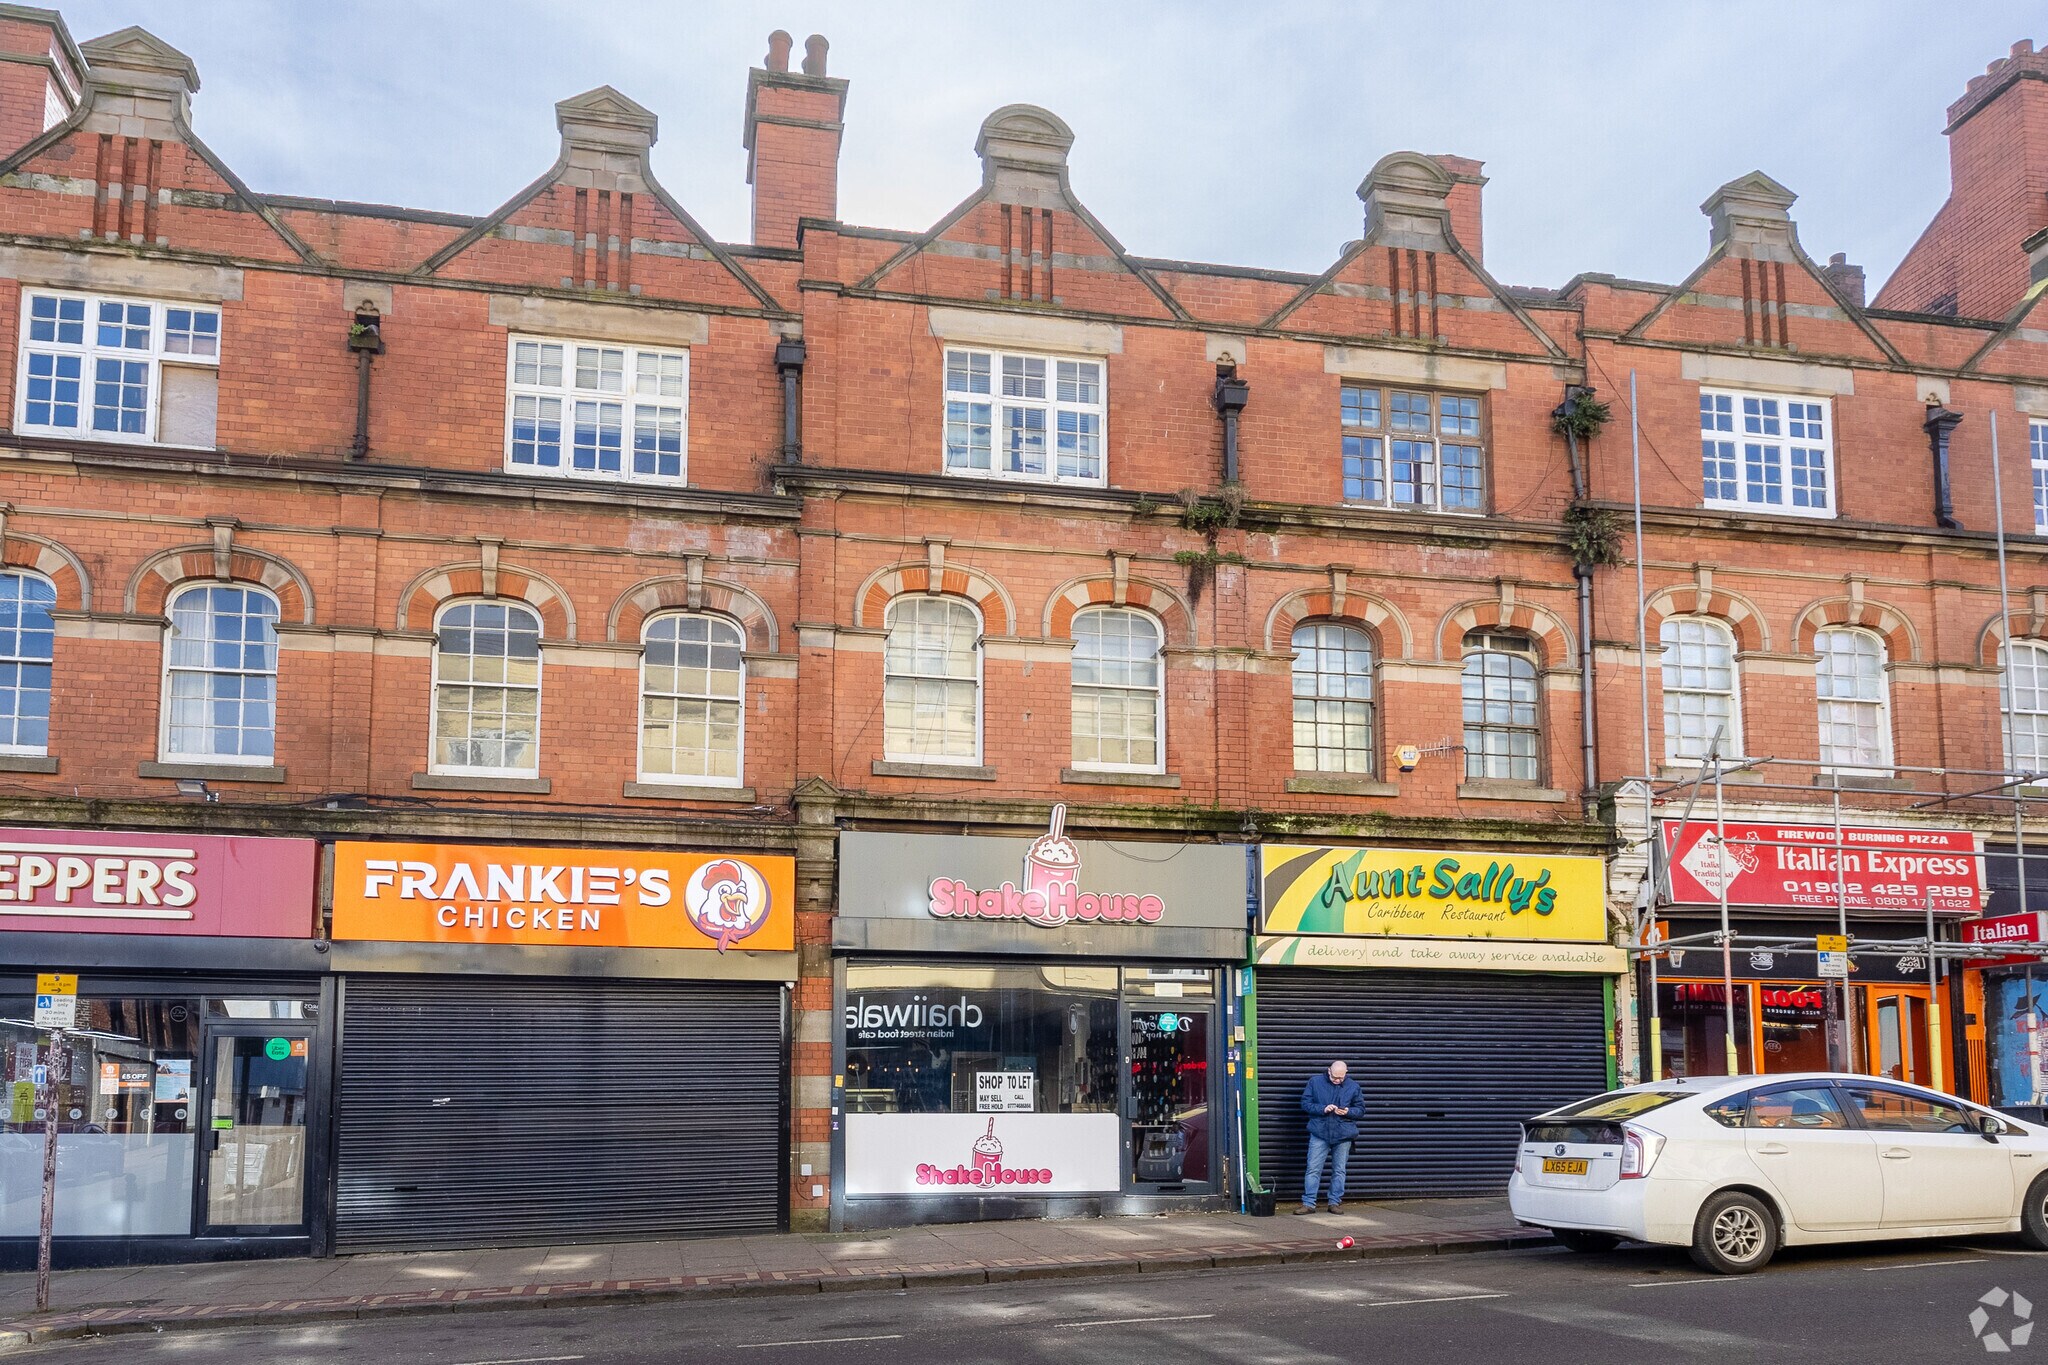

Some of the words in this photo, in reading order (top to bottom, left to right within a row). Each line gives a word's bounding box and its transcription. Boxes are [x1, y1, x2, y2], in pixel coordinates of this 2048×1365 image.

[1848, 832, 1905, 843] BURNING
[1909, 835, 1949, 844] PIZZA
[1776, 846, 1861, 872] Italian
[1868, 851, 1970, 881] Express
[0, 854, 196, 907] EPPERS
[364, 859, 672, 907] FRANKIE'S
[1321, 860, 1426, 909] Aunt
[1429, 857, 1558, 916] Sally's
[1705, 879, 1720, 887] Foo
[1783, 880, 1863, 894] 01902
[1871, 883, 1918, 896] 425
[1925, 885, 1973, 897] 289
[929, 876, 1047, 919] Shake
[1047, 881, 1165, 922] House
[1792, 894, 1822, 903] FREE
[1875, 897, 1908, 905] 0808
[1939, 899, 1971, 908] 1622
[437, 905, 601, 931] CHICKEN
[1367, 902, 1425, 920] Caribbean
[1441, 904, 1506, 922] Restaurant
[1972, 922, 2029, 941] Italian
[1307, 945, 1366, 959] delivery
[1371, 946, 1403, 958] and
[1411, 948, 1442, 959] take
[1448, 951, 1486, 962] away
[1490, 951, 1538, 962] service
[979, 1075, 1003, 1089] SHOP
[1007, 1076, 1017, 1089] TO
[1018, 1076, 1031, 1089] LET
[979, 1094, 989, 1102] MAY
[990, 1094, 1002, 1102] SELL
[915, 1163, 983, 1186] Shake
[984, 1162, 1053, 1185] House
[1545, 1160, 1565, 1172] LX65
[1567, 1161, 1583, 1173] EJA
